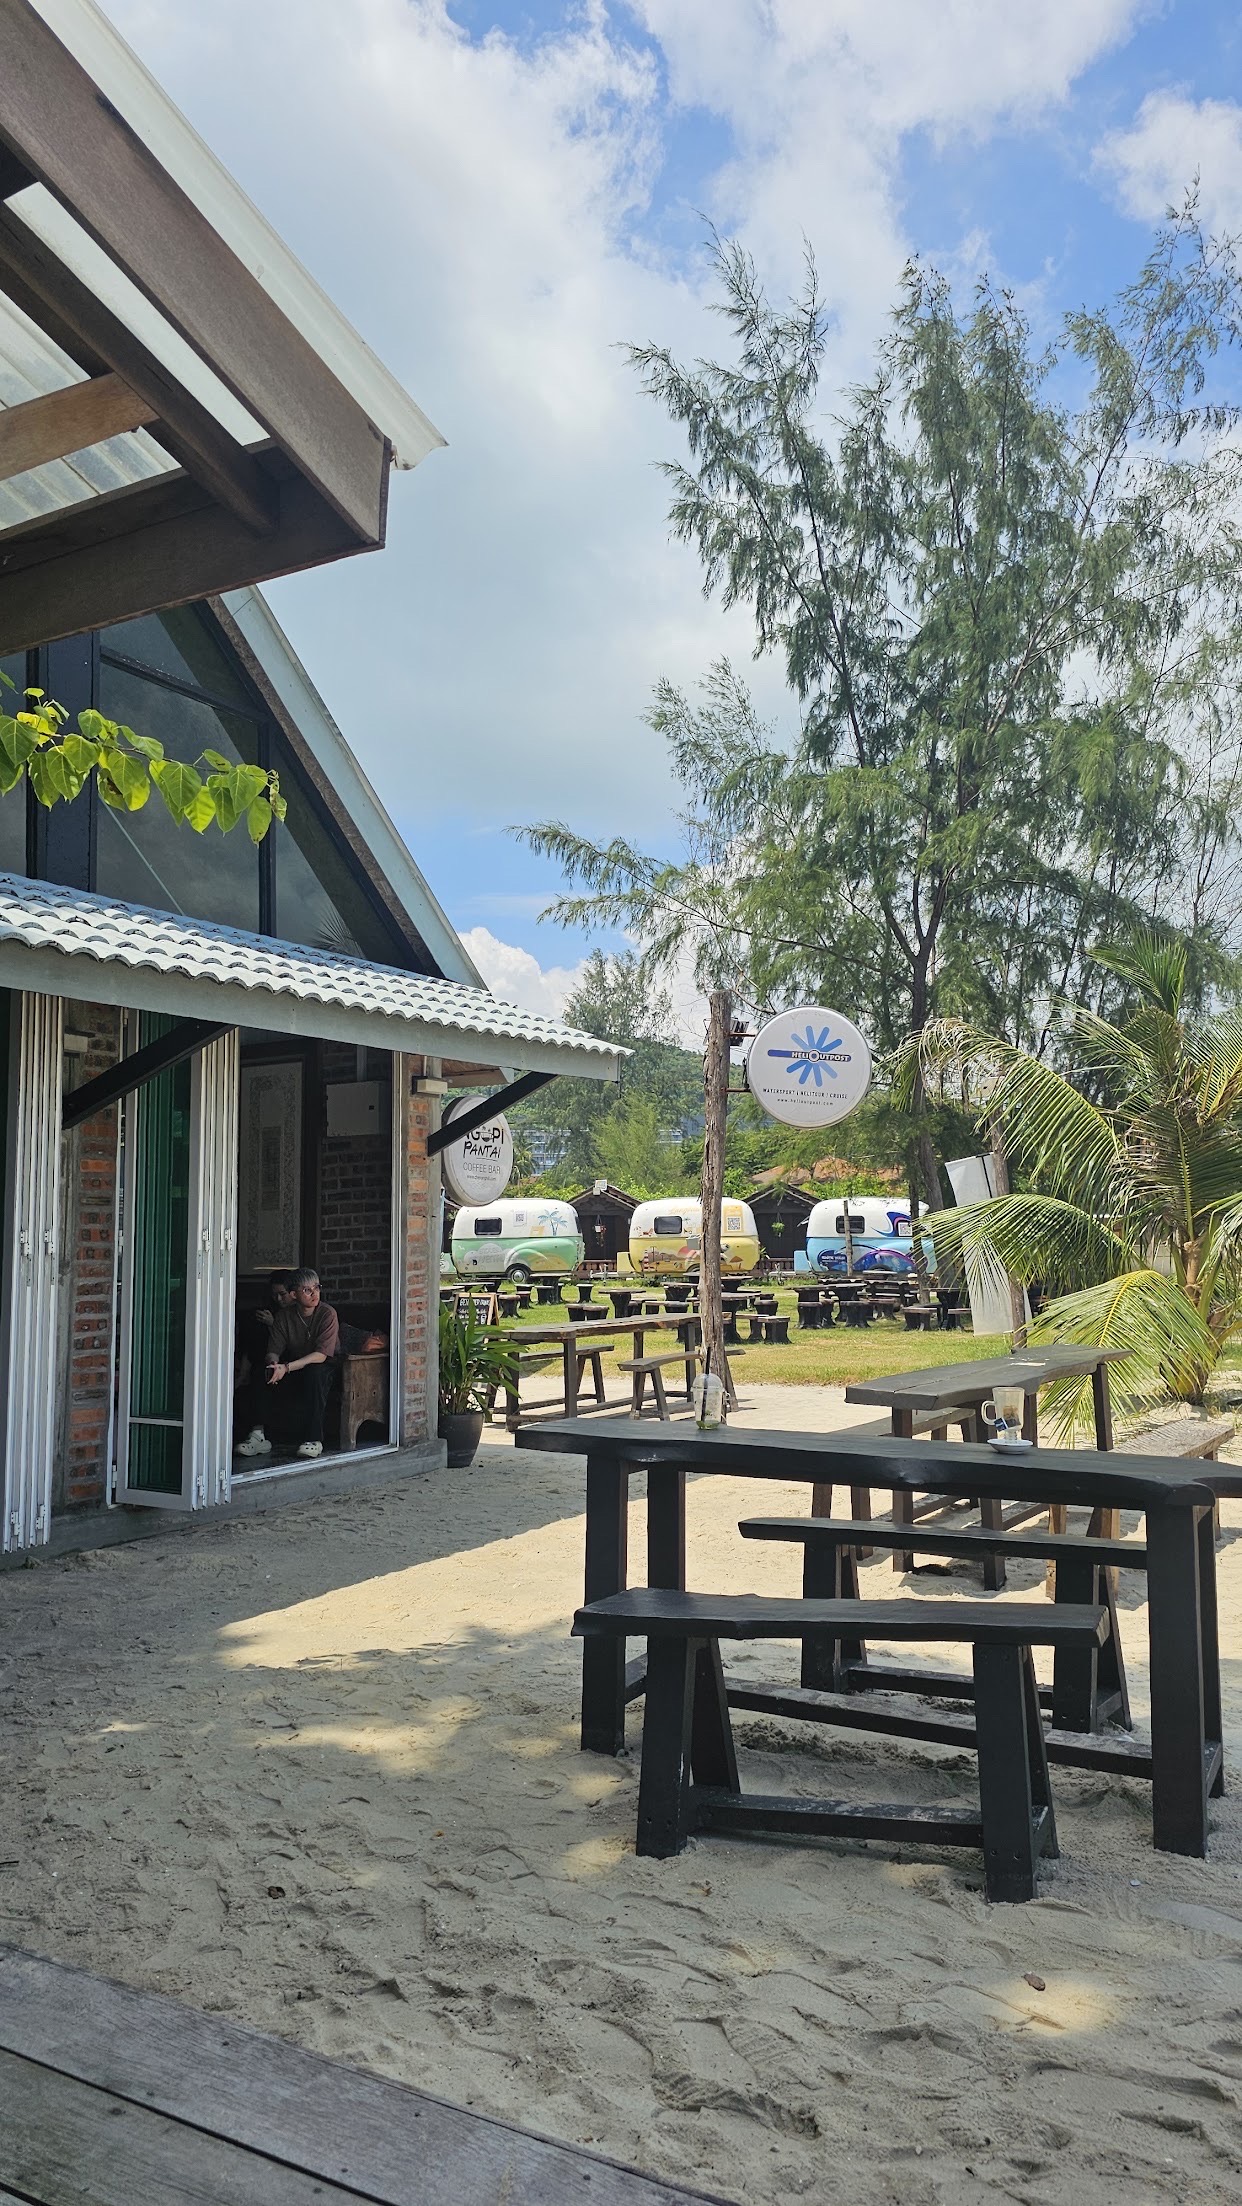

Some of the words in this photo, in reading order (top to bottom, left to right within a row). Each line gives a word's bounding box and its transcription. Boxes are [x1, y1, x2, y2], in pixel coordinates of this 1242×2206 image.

[463, 1141, 501, 1158] PANTAI
[463, 1162, 487, 1173] COFFEE
[488, 1164, 501, 1174] BAR
